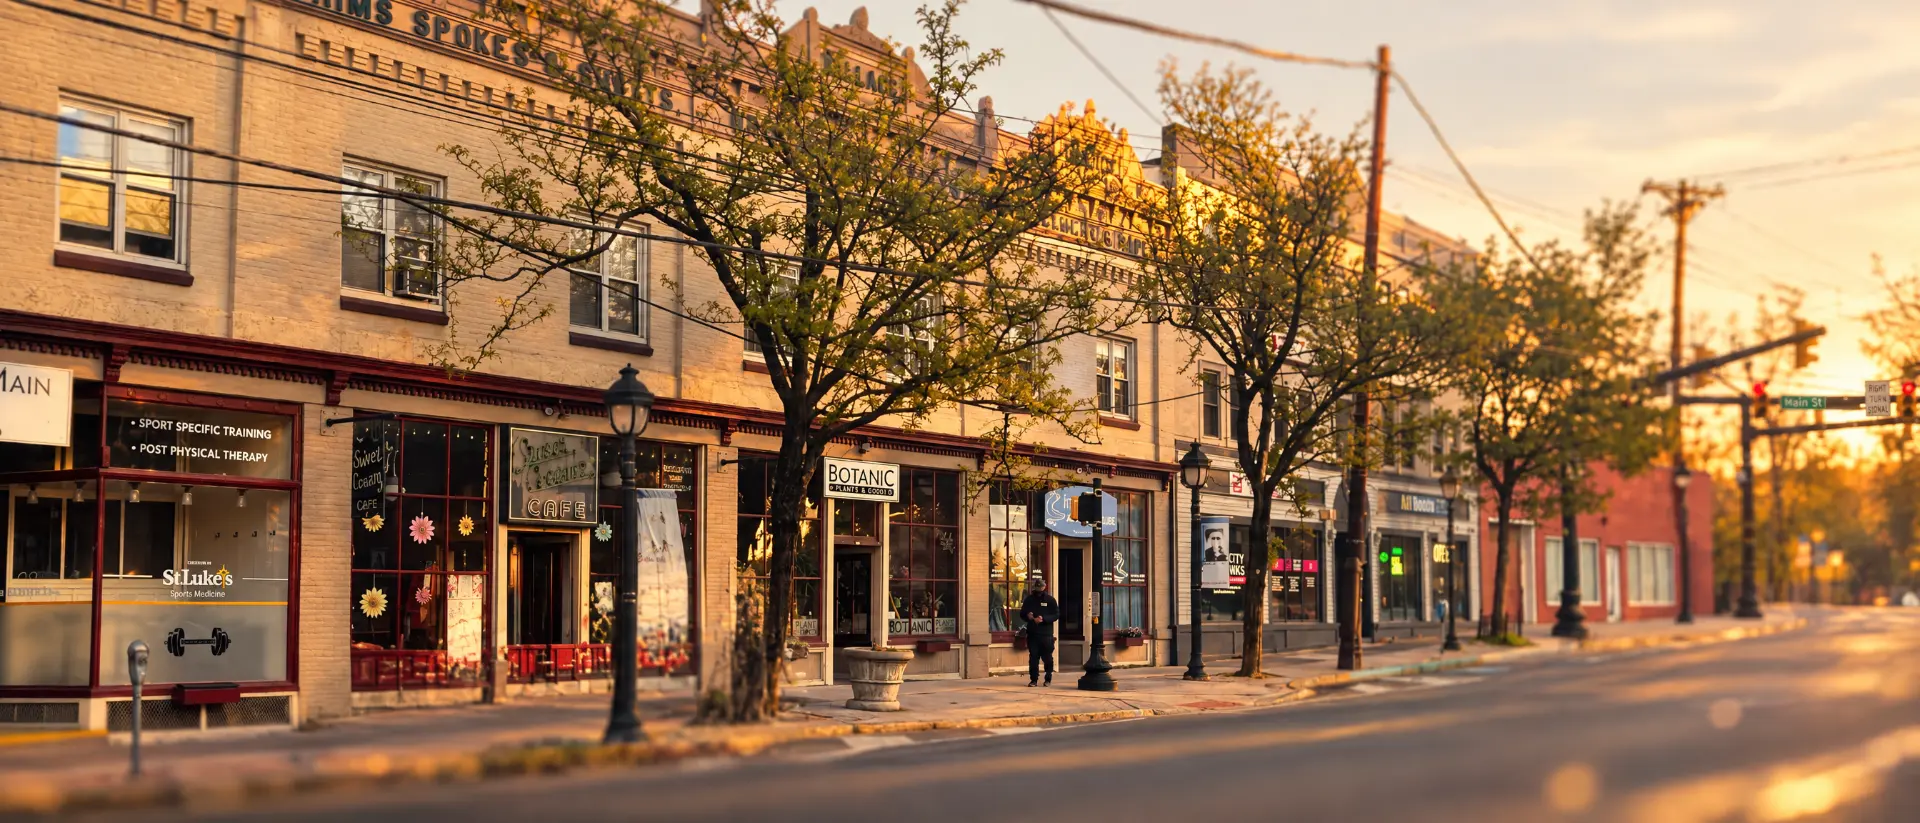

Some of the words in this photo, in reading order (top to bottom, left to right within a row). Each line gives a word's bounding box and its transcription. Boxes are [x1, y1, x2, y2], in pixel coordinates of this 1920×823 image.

[413, 10, 530, 68] SPOKES
[1868, 384, 1887, 392] RIGHT
[1784, 398, 1808, 408] Main
[1811, 398, 1822, 407] St
[1869, 395, 1887, 403] TURN
[1867, 406, 1889, 414] SIGNAL
[139, 418, 174, 431] SPORT
[175, 421, 221, 435] SPECIFIC
[223, 426, 272, 439] TRAINING
[139, 443, 168, 455] POST
[170, 446, 221, 459] PHYSICAL
[223, 450, 269, 462] THERAPY
[828, 463, 895, 487] BOTANIC
[835, 485, 859, 493] PLANTS
[356, 499, 378, 511] CAFE
[527, 498, 586, 519] CAFE
[170, 590, 193, 600] Sports
[194, 590, 226, 599] Medicine
